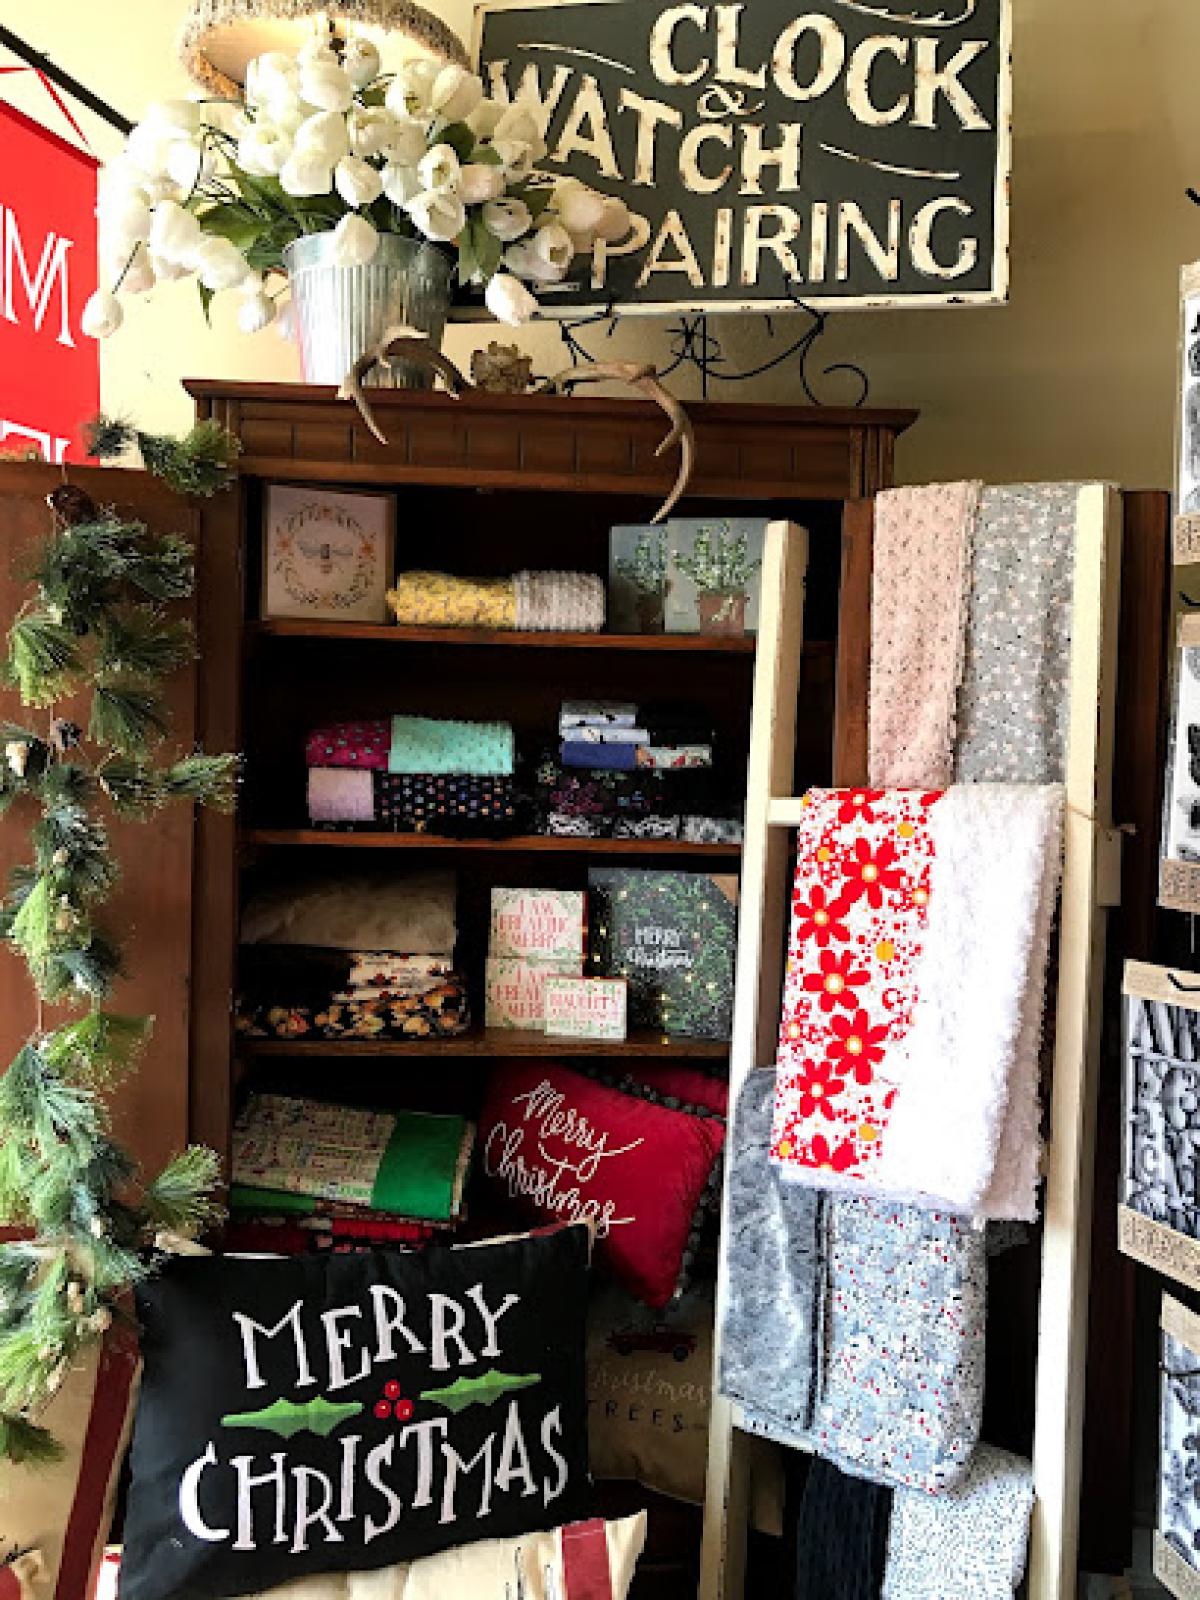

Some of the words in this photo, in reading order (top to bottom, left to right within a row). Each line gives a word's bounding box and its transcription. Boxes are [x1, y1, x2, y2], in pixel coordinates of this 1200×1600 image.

[649, 3, 992, 132] CLOCK
[698, 82, 766, 119] &
[484, 1121, 636, 1239] Christmas
[511, 1078, 645, 1183] Merry
[231, 1282, 521, 1391] MERRY
[179, 1400, 569, 1554] CHRISTMAS
